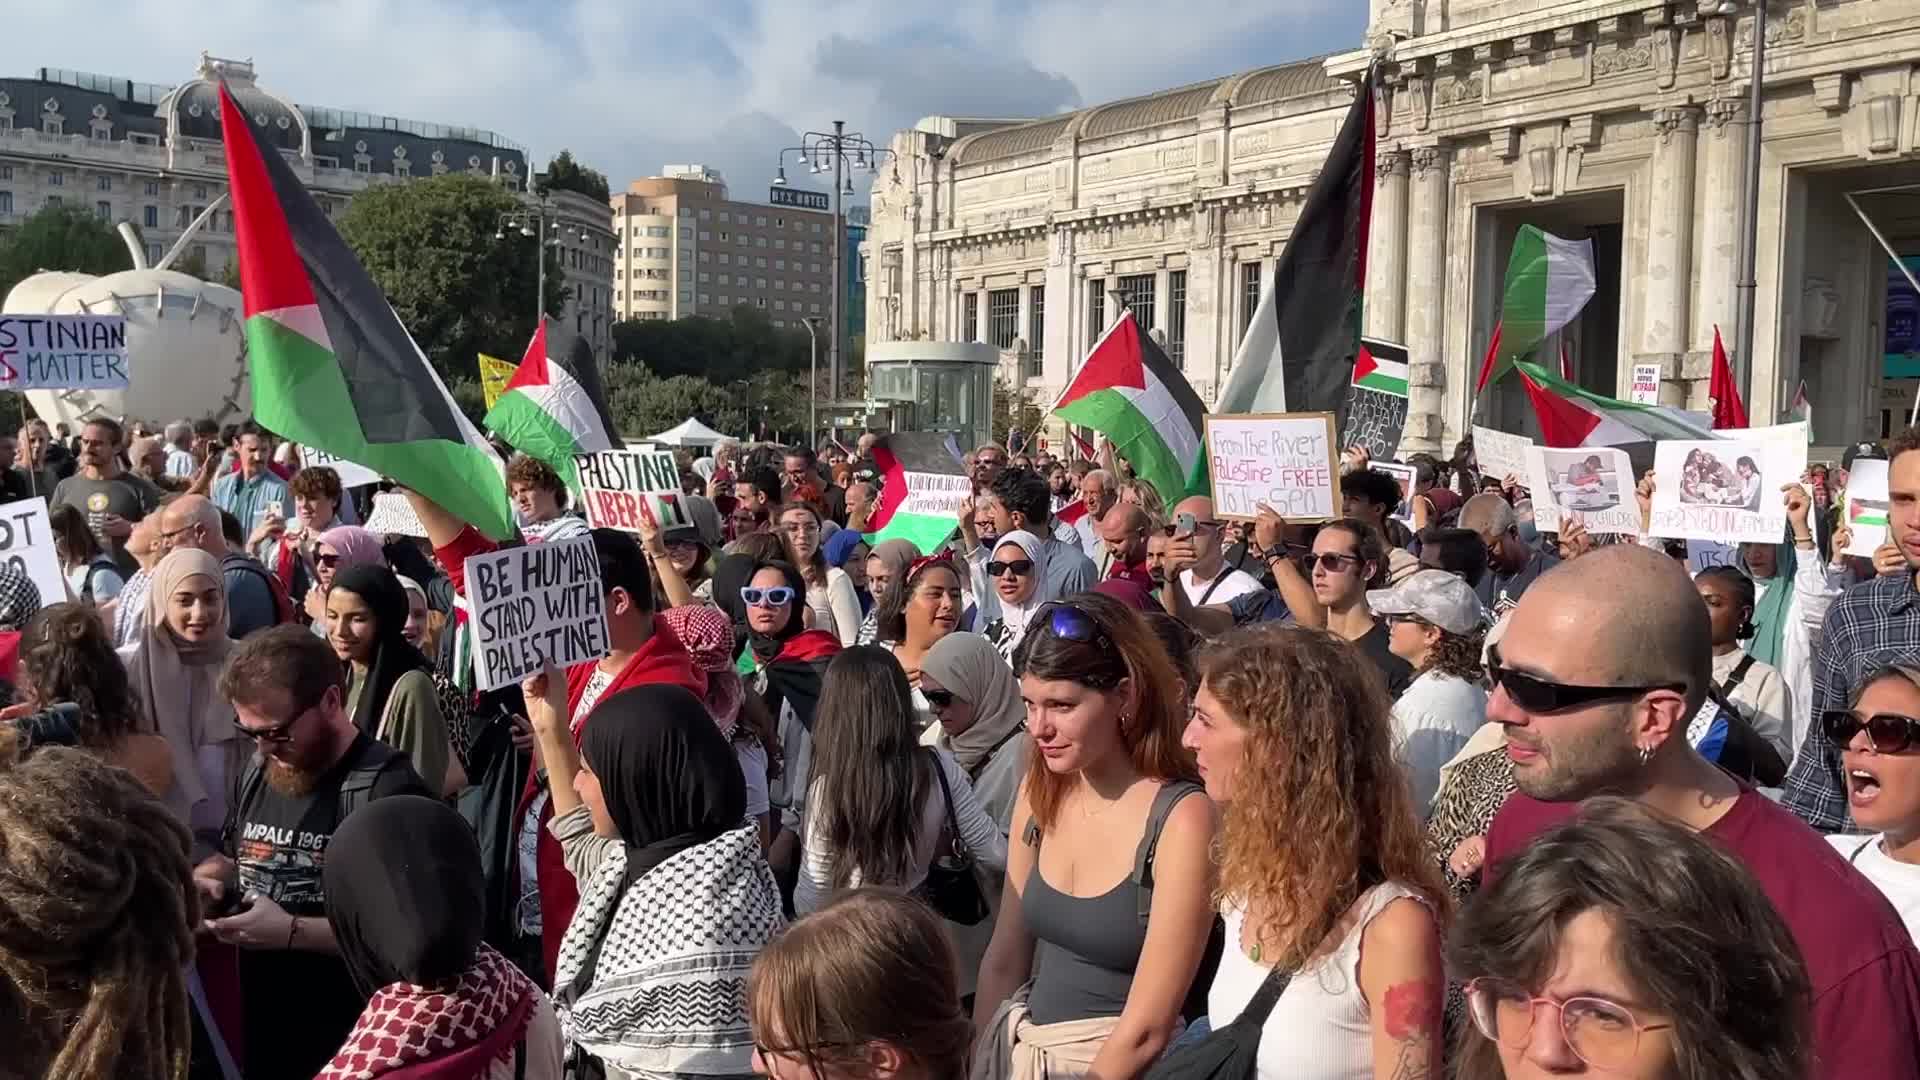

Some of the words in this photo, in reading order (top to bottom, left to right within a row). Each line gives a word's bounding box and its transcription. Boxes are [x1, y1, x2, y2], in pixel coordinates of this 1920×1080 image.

[796, 192, 827, 208] HOTEL
[0, 319, 125, 350] STINIAN
[26, 351, 129, 382] MATTER
[1272, 430, 1322, 457] River
[1282, 469, 1329, 489] FREE
[580, 489, 658, 529] LIBERA
[477, 556, 513, 604] BE
[521, 539, 600, 592] HUMAN
[480, 595, 536, 643] STAND
[544, 581, 600, 621] WITH
[486, 615, 611, 687] PALESTINE!
